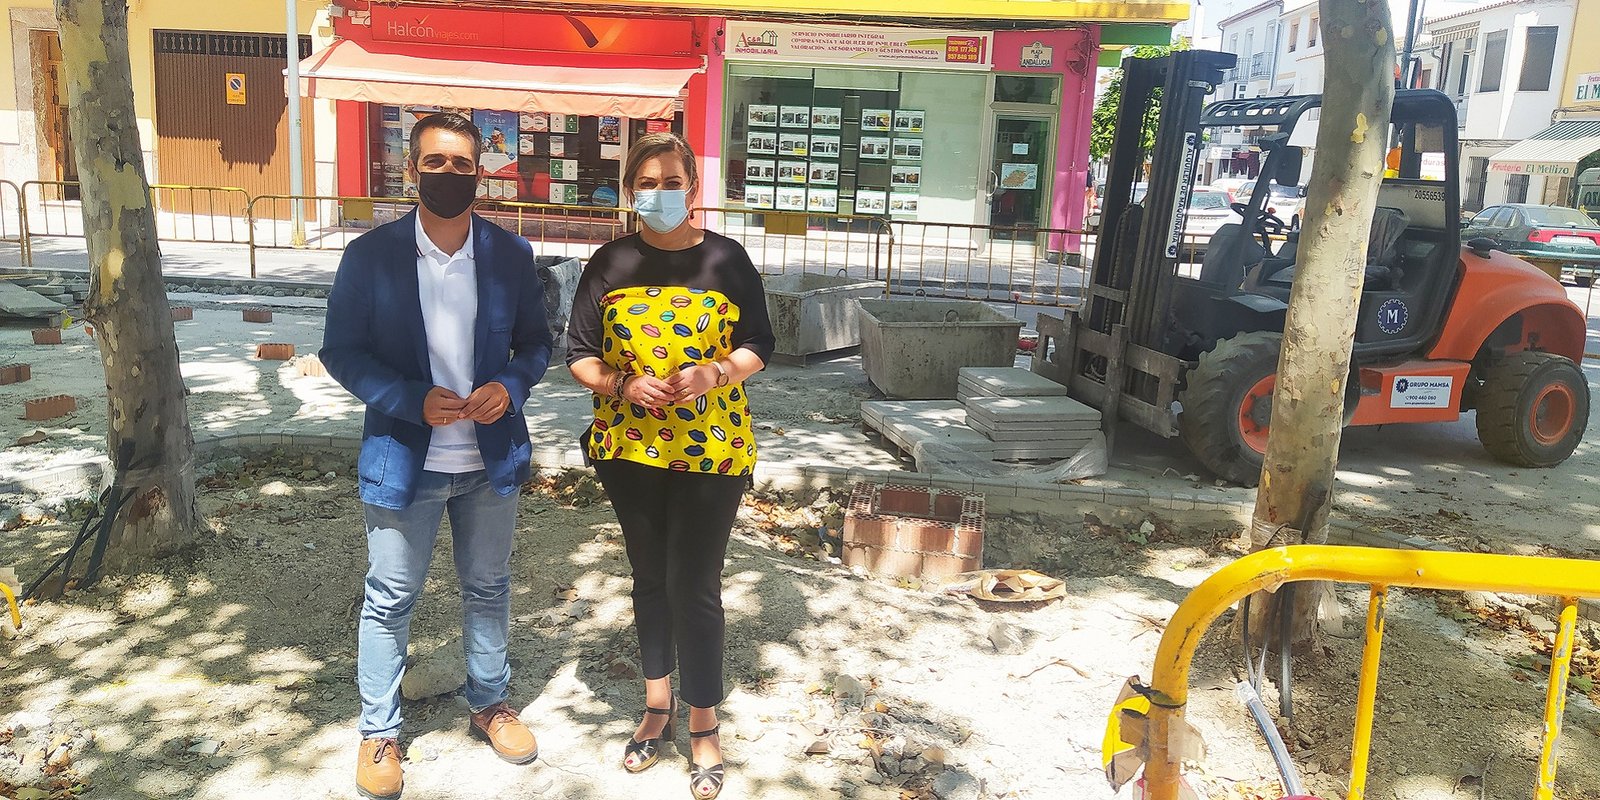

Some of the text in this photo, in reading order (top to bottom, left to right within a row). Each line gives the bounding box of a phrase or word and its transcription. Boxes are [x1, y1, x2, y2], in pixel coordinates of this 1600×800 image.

[735, 47, 778, 55] INMOBILIARIA
[1182, 147, 1193, 184] ALQUILER
[1525, 164, 1535, 173] El
[1536, 164, 1569, 174] Mellizo
[1180, 185, 1187, 195] DE
[1171, 196, 1185, 243] MAQUINARIA
[1386, 309, 1399, 324] M
